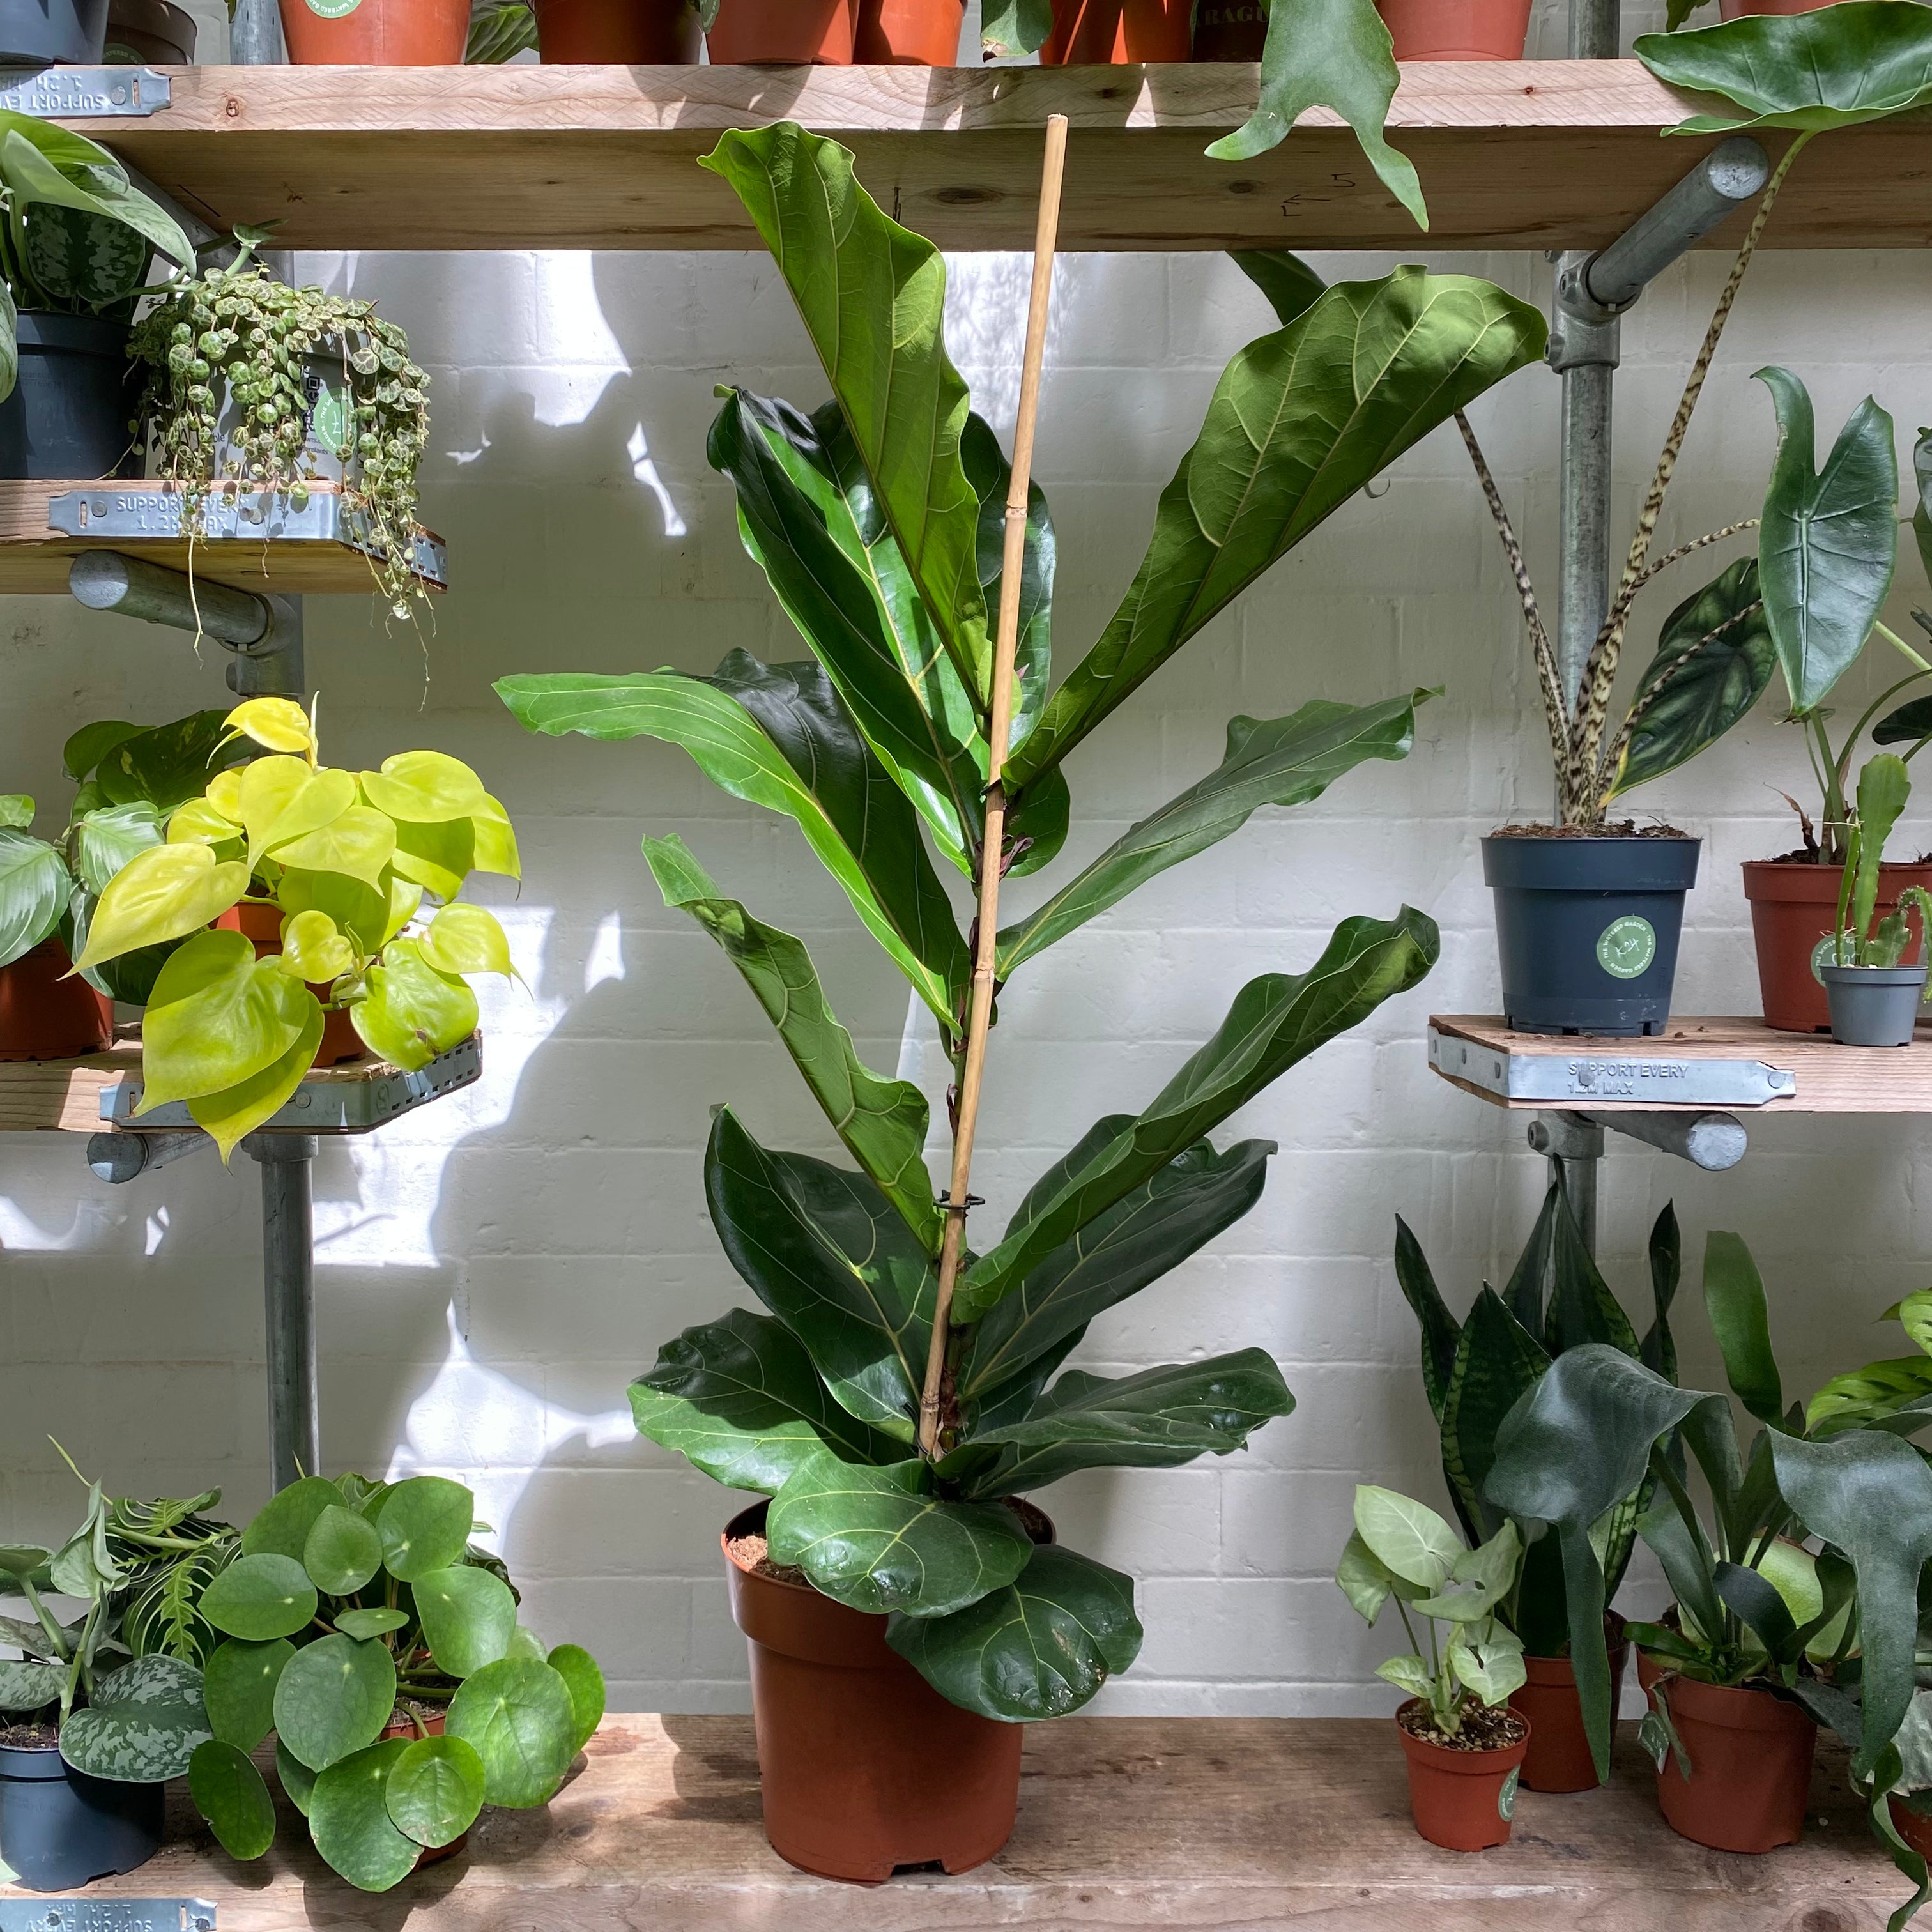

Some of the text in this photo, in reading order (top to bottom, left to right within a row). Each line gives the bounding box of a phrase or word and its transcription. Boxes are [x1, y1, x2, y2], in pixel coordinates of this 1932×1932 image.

[29, 95, 106, 110] SUPPORT
[1602, 924, 1623, 946] WATERED
[1640, 1063, 1689, 1078] EVERY
[1602, 1081, 1634, 1095] MAX
